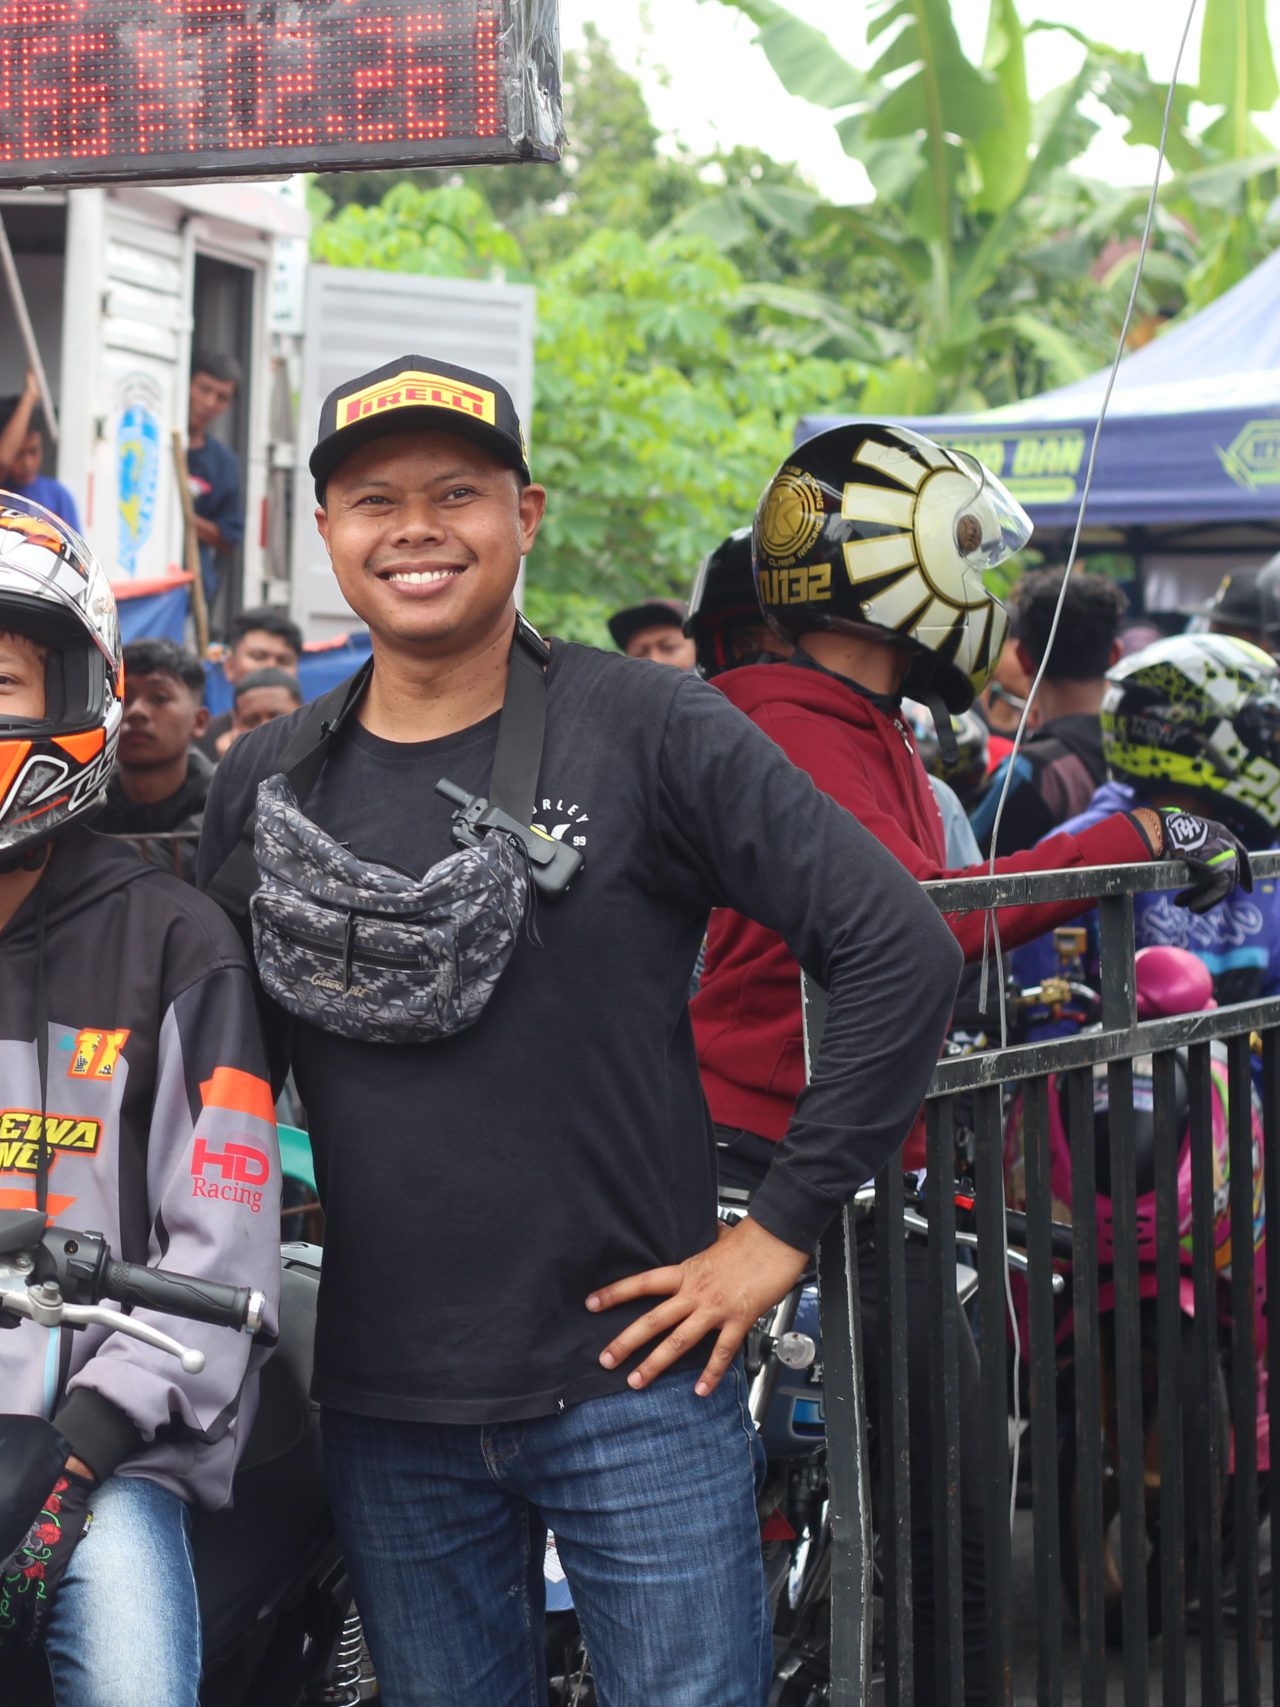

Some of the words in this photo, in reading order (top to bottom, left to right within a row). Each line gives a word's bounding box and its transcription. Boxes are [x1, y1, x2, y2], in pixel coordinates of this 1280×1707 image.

[345, 379, 484, 424] PIRELLI
[572, 835, 587, 847] 99
[190, 1137, 270, 1186] HD
[191, 1176, 264, 1213] Racing
